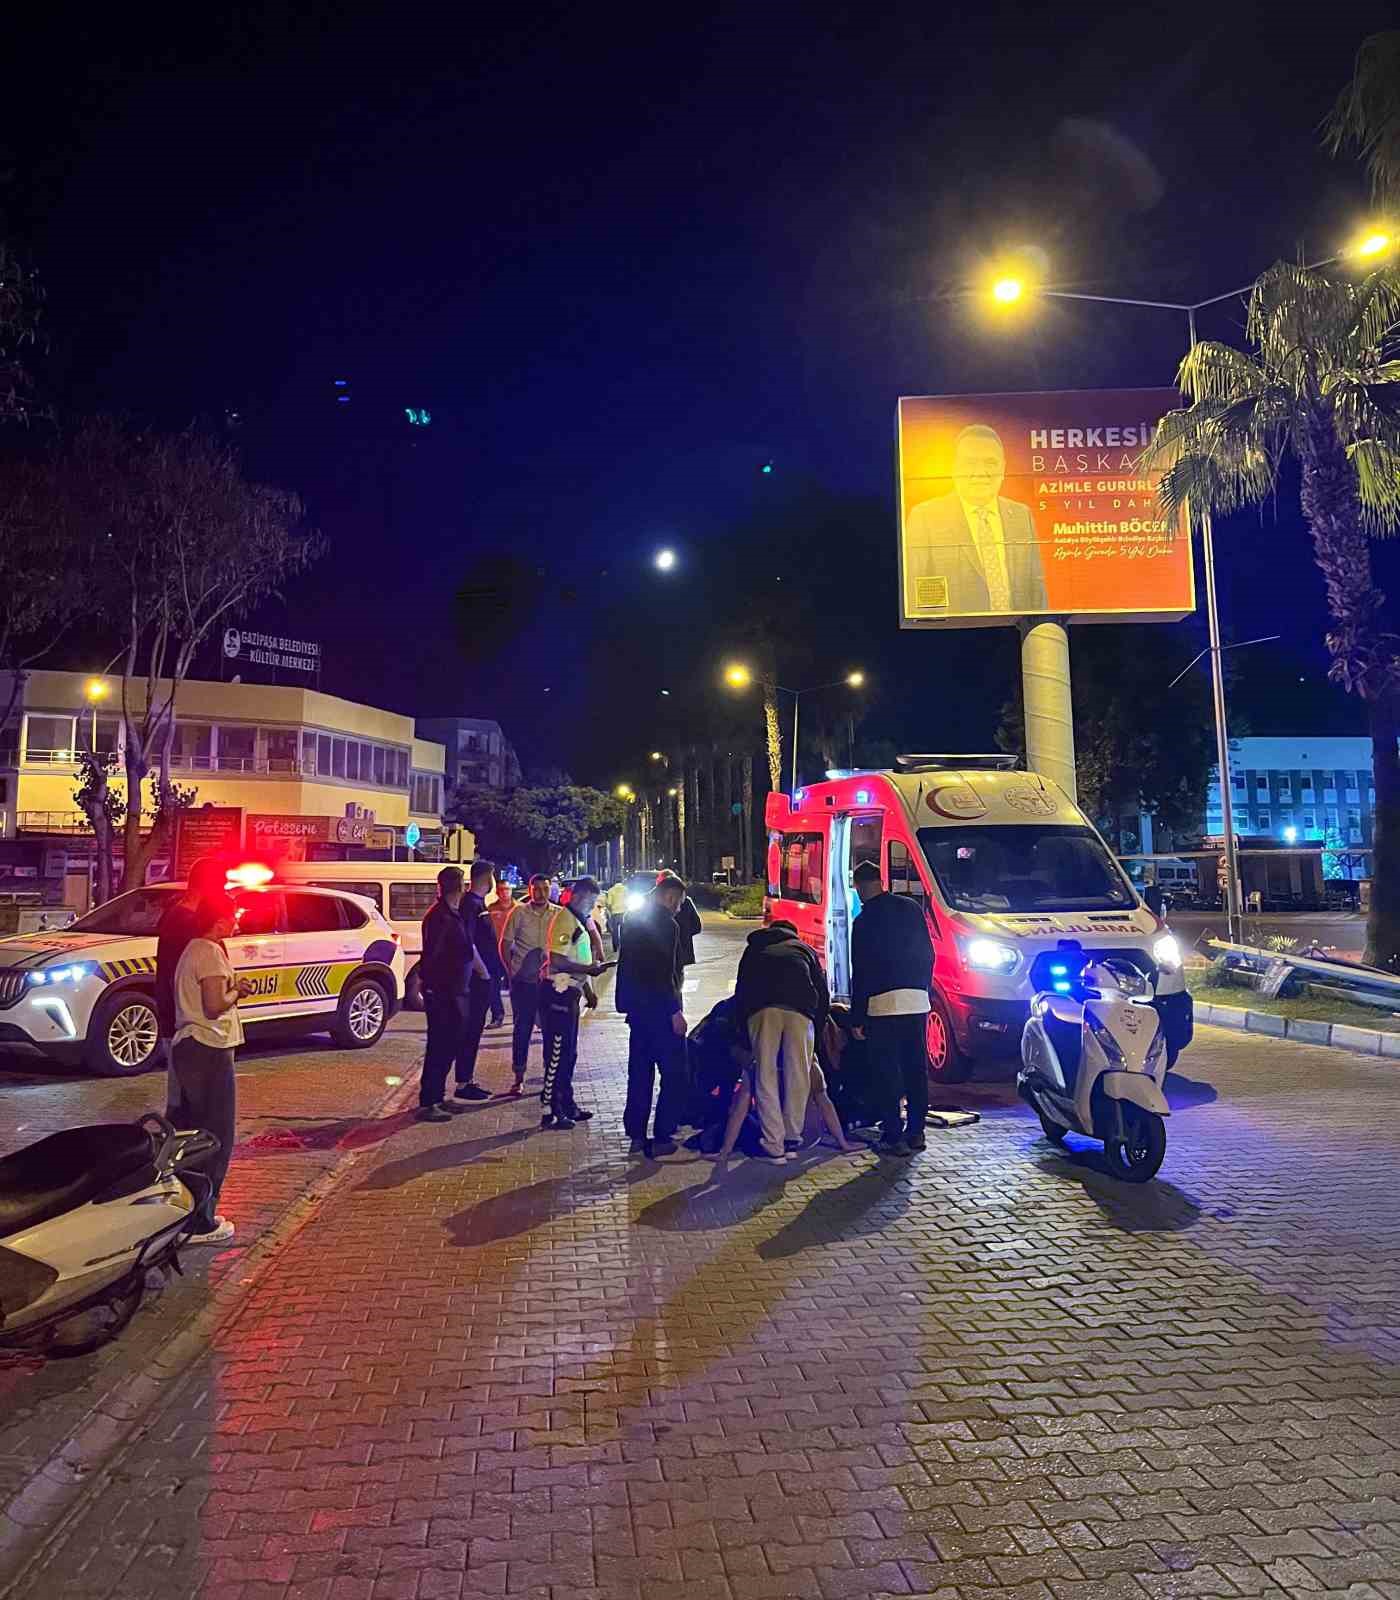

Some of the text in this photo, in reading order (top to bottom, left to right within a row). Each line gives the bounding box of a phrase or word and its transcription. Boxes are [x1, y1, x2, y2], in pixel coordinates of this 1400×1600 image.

[1031, 422, 1157, 448] HERKESİ
[1032, 454, 1134, 473] BAŞKA
[1039, 480, 1155, 494] AZİMLE GURURL
[1039, 499, 1151, 511] 5 YIL DAH
[1053, 521, 1117, 534] Muhittin
[249, 648, 279, 666] KÜLTÜR
[250, 974, 278, 996] OLİSİ
